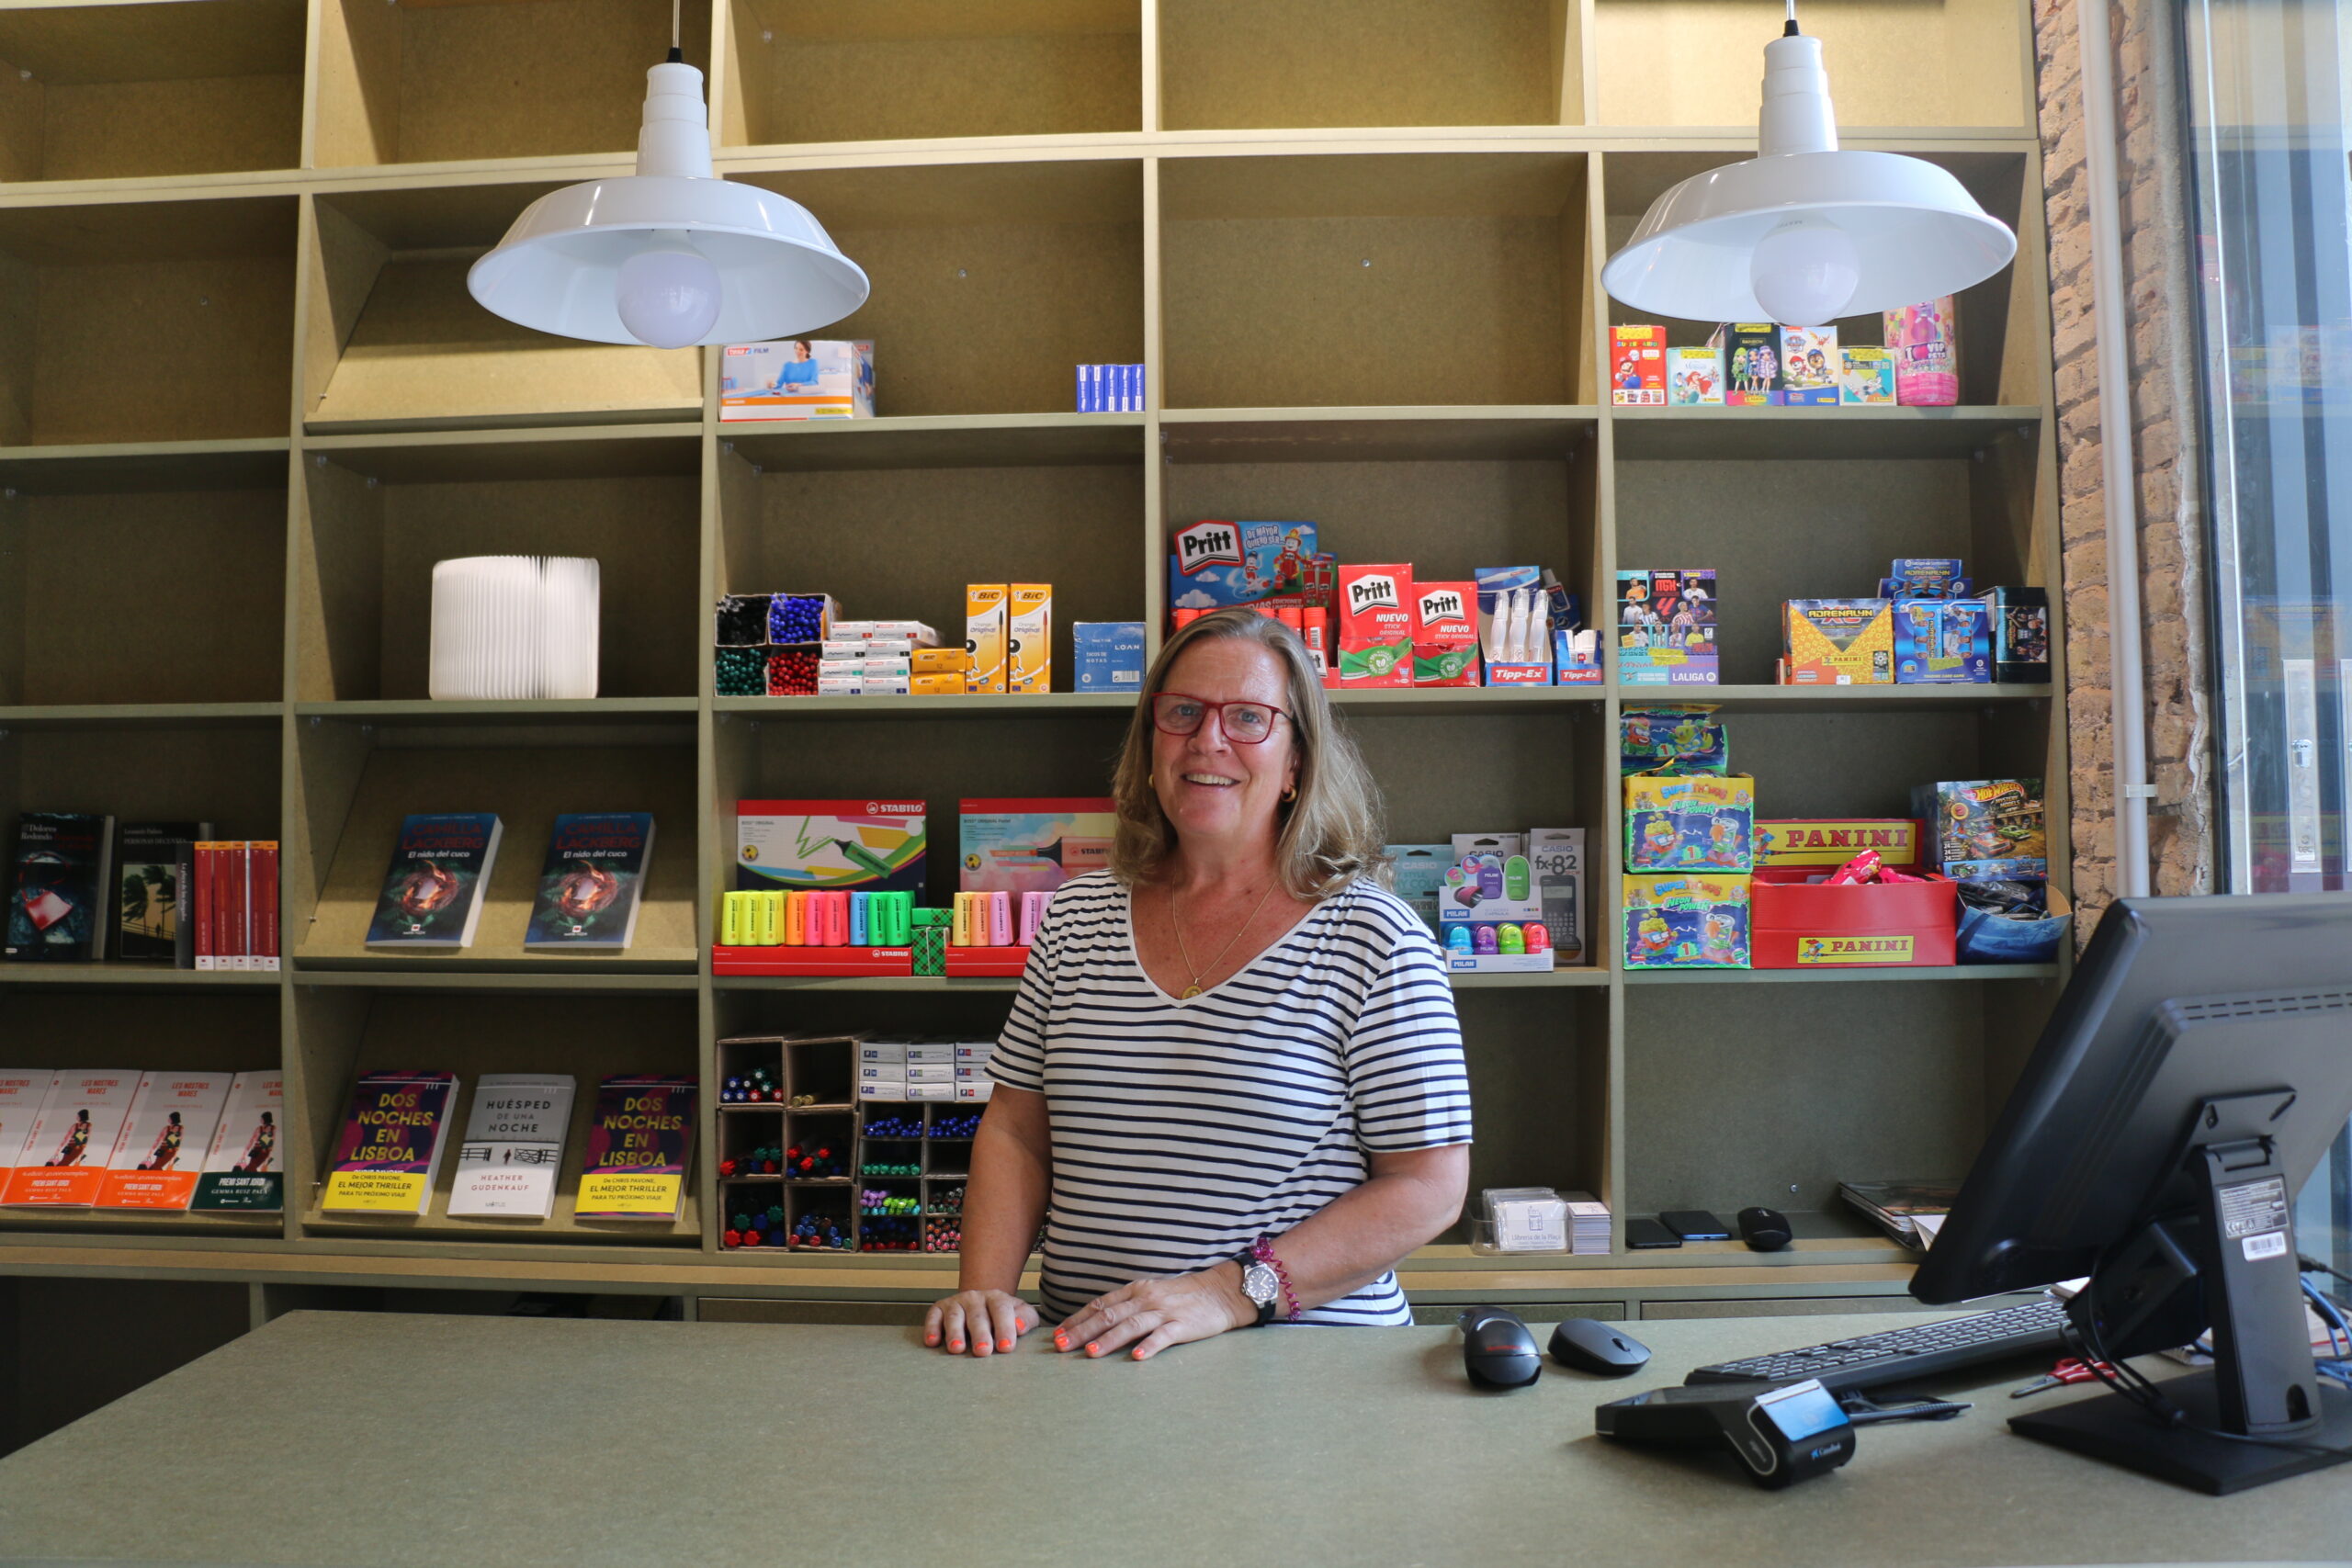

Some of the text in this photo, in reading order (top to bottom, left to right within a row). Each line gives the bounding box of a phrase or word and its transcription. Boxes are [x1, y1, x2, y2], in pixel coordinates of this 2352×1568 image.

[1927, 343, 1945, 353] VIP
[1256, 525, 1279, 536] MAYOR
[1182, 531, 1231, 557] Pritt
[1246, 536, 1268, 549] QUIERO
[1351, 581, 1392, 603] Pritt
[1424, 595, 1458, 615] Pritt
[1376, 614, 1409, 623] NUEVO
[1441, 625, 1470, 633] NUEVO
[1496, 670, 1543, 680] Tipp-Ex
[1564, 671, 1597, 680] Tipp-Ex
[1672, 672, 1705, 682] LALIGA
[1660, 744, 1668, 755] 1
[1976, 788, 1994, 801] HOT
[1674, 799, 1699, 810] NEON
[1685, 805, 1716, 814] POWER
[1999, 800, 2020, 808] MODELS
[29, 824, 57, 832] Dolores
[412, 823, 482, 836] CAMILLA
[566, 823, 638, 836] CAMILLA
[1786, 829, 1908, 847] PANINI
[592, 850, 606, 858] del
[1687, 847, 1694, 858] 1
[1402, 862, 1437, 870] CASIO
[1534, 854, 1577, 875] fx-82
[1667, 897, 1692, 908] NEON
[1679, 902, 1710, 911] POWER
[1682, 942, 1690, 955] 1
[1831, 941, 1908, 952] PANINI
[379, 1093, 417, 1108] DOS
[486, 1099, 551, 1110] HUÉSPED
[625, 1097, 663, 1111] DOS
[357, 1111, 434, 1126] NOCHES
[603, 1115, 683, 1130] NOCHES
[375, 1129, 401, 1143] EN
[623, 1134, 649, 1148] EN
[350, 1146, 414, 1161] LISBOA
[599, 1152, 667, 1167] LISBOA
[219, 1178, 266, 1186] PREMI SANT JORDI
[601, 1185, 627, 1193] MEJOR
